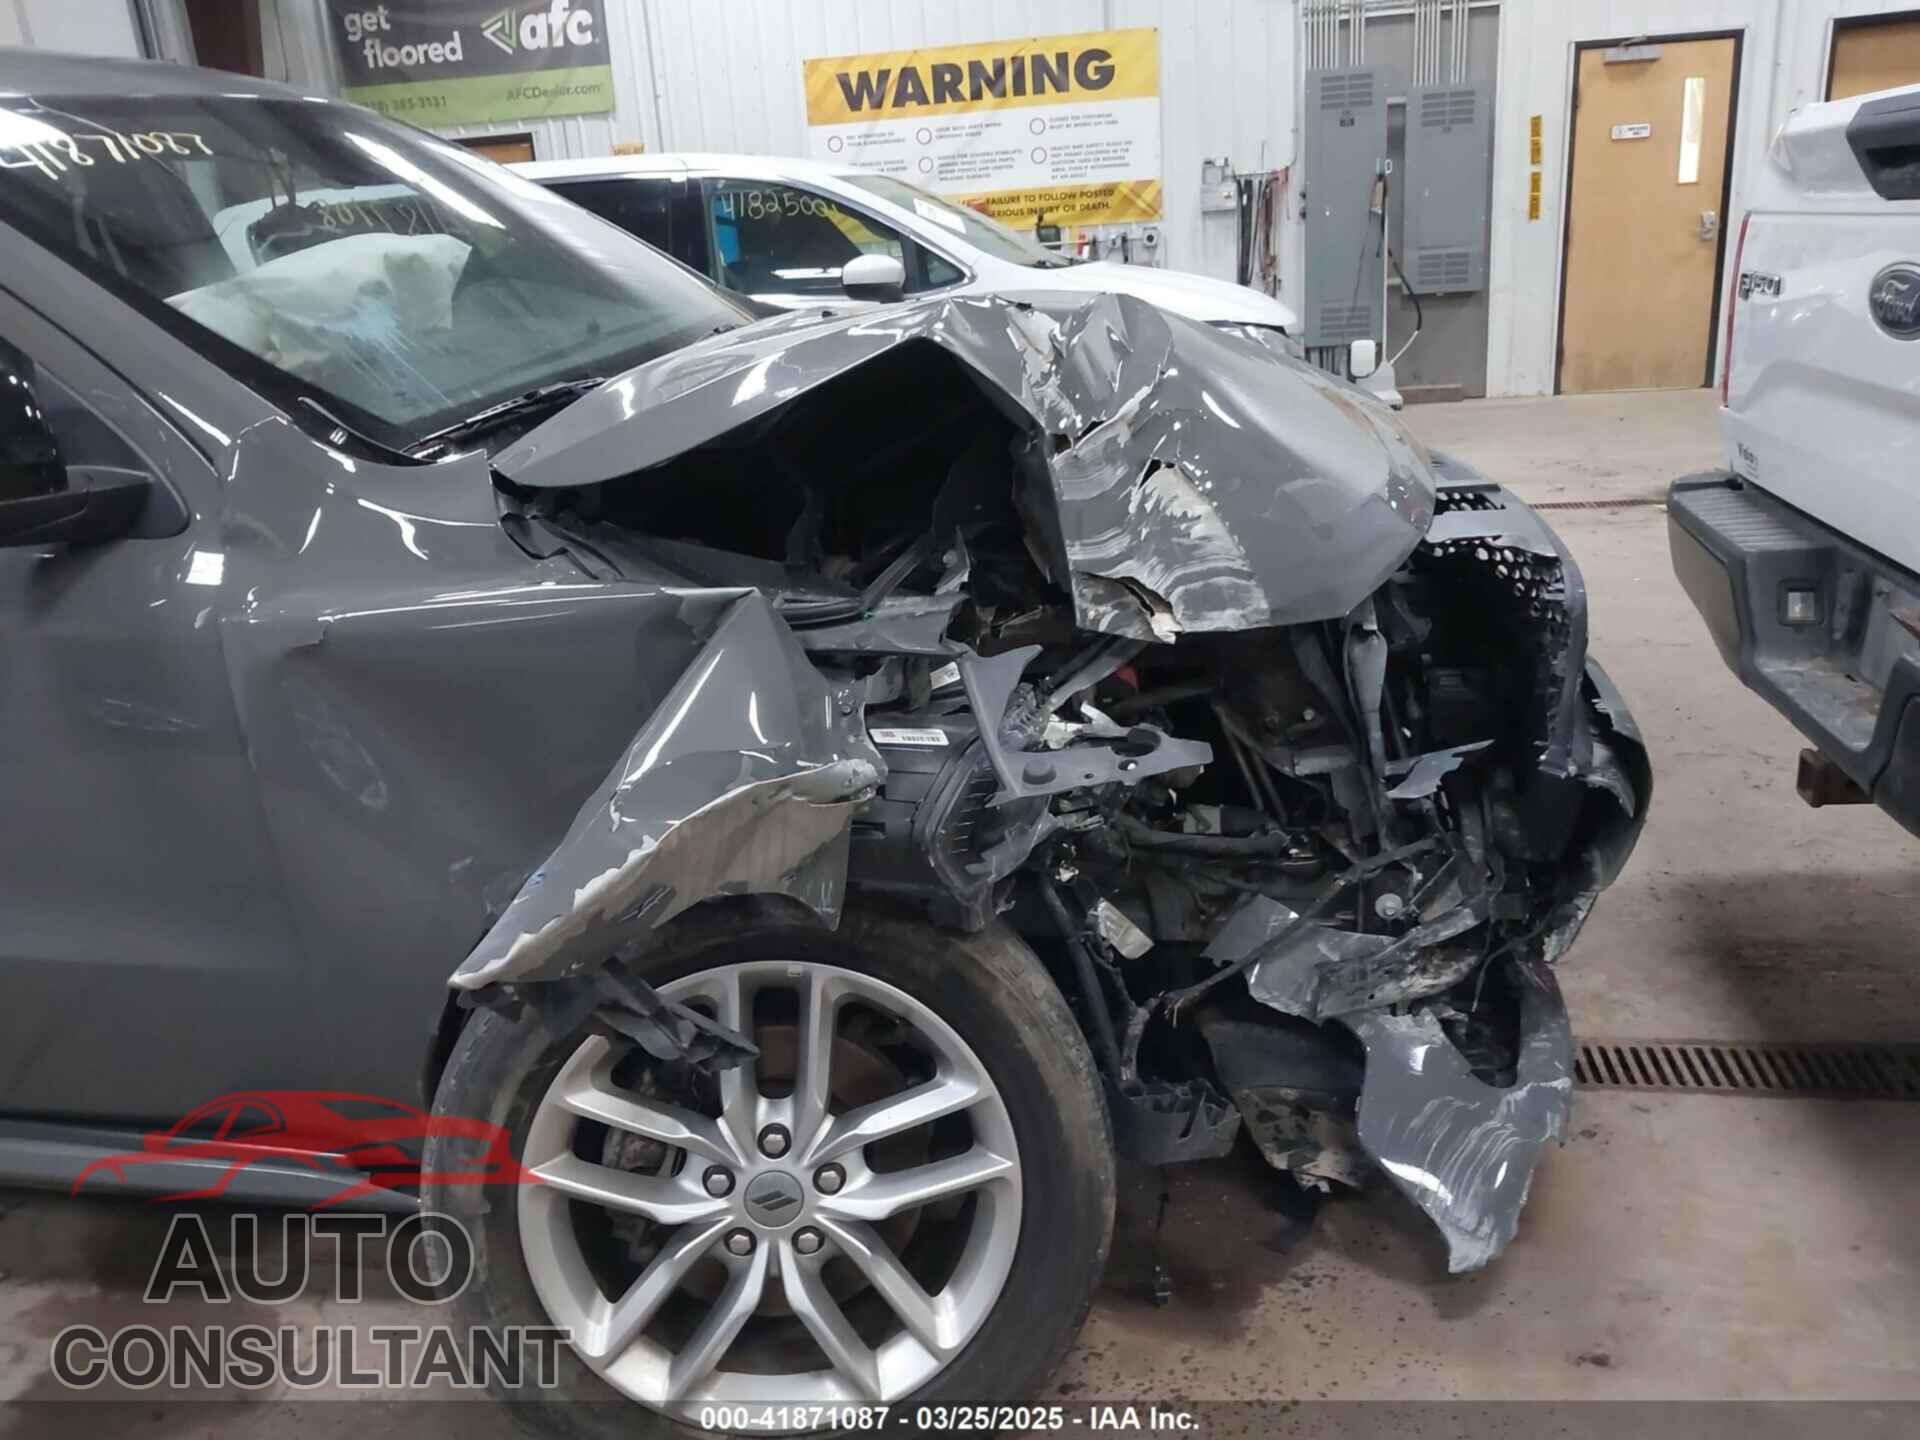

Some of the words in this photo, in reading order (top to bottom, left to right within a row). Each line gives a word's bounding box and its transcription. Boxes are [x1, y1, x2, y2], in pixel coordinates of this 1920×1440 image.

[344, 5, 391, 42] get
[519, 0, 593, 50] afc
[363, 31, 464, 69] floored
[836, 48, 1116, 112] WARNING
[986, 194, 1021, 206] FAILURE
[1024, 193, 1035, 203] TO
[1039, 191, 1077, 202] FOLLOW
[1080, 188, 1115, 199] POSTED
[990, 207, 1025, 217] ERIOUS
[1064, 203, 1076, 213] OR
